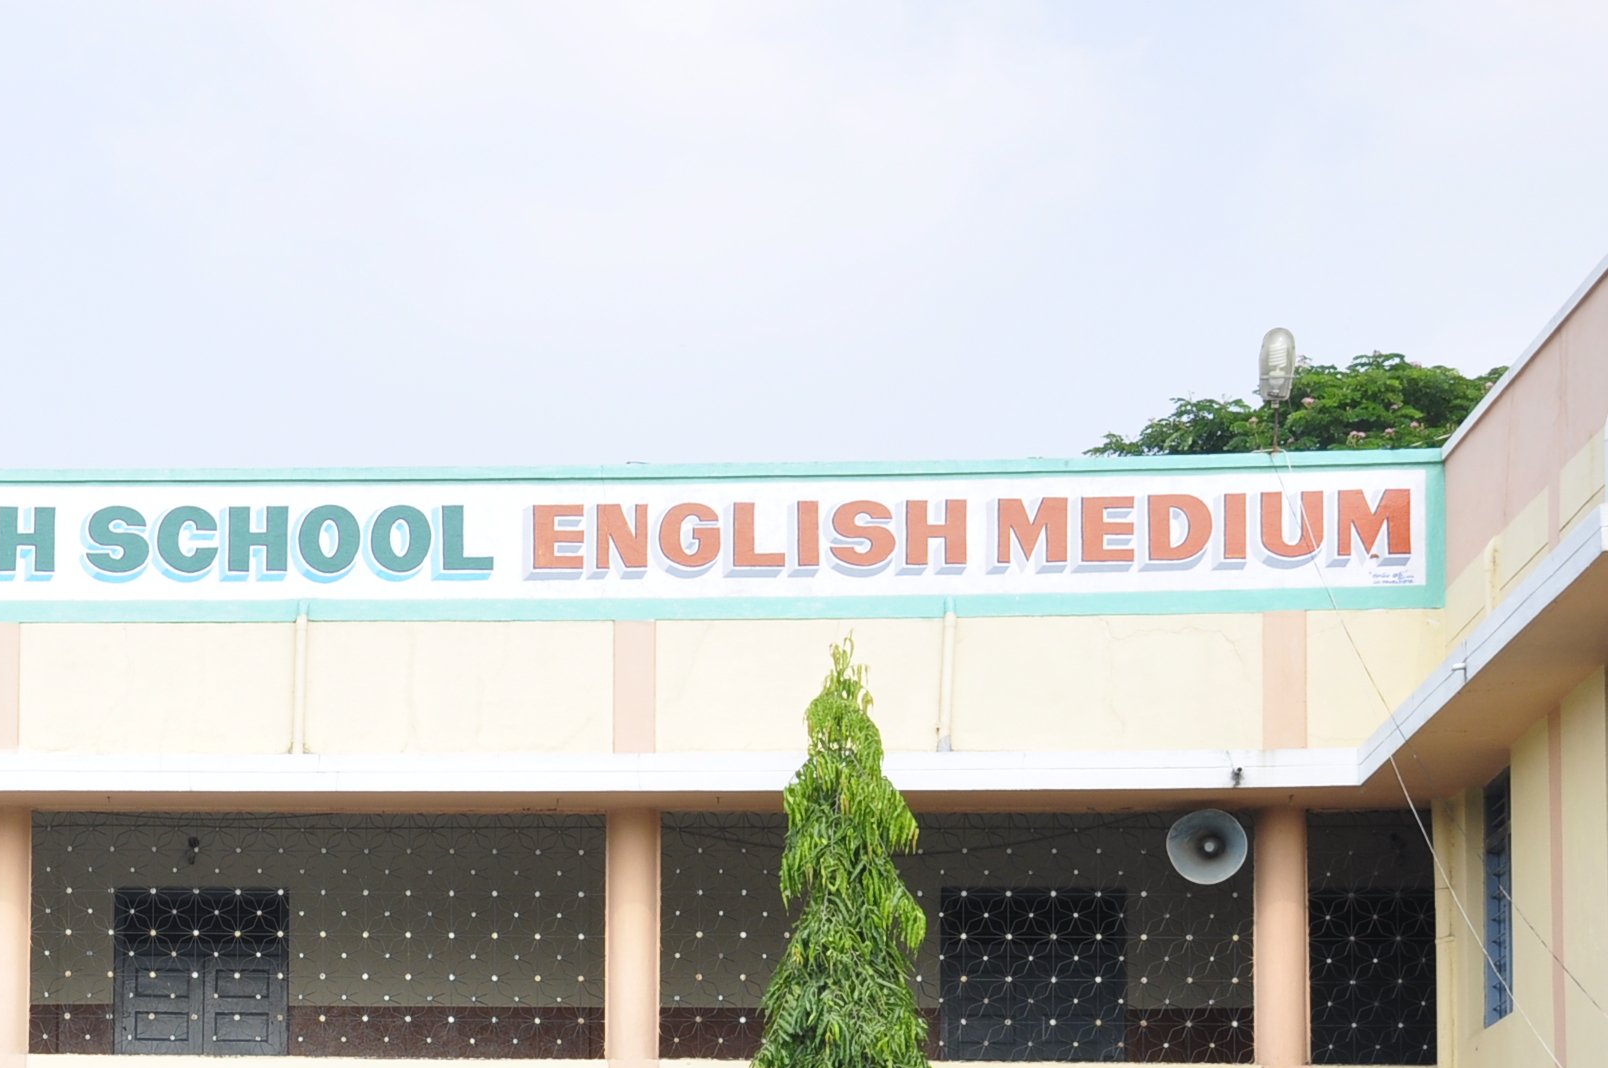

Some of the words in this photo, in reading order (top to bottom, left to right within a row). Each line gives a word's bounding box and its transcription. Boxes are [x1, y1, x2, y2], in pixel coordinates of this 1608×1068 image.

[79, 503, 494, 584] SCHOOL
[522, 498, 968, 581] ENGLISH
[984, 488, 1412, 574] MEDIUM
